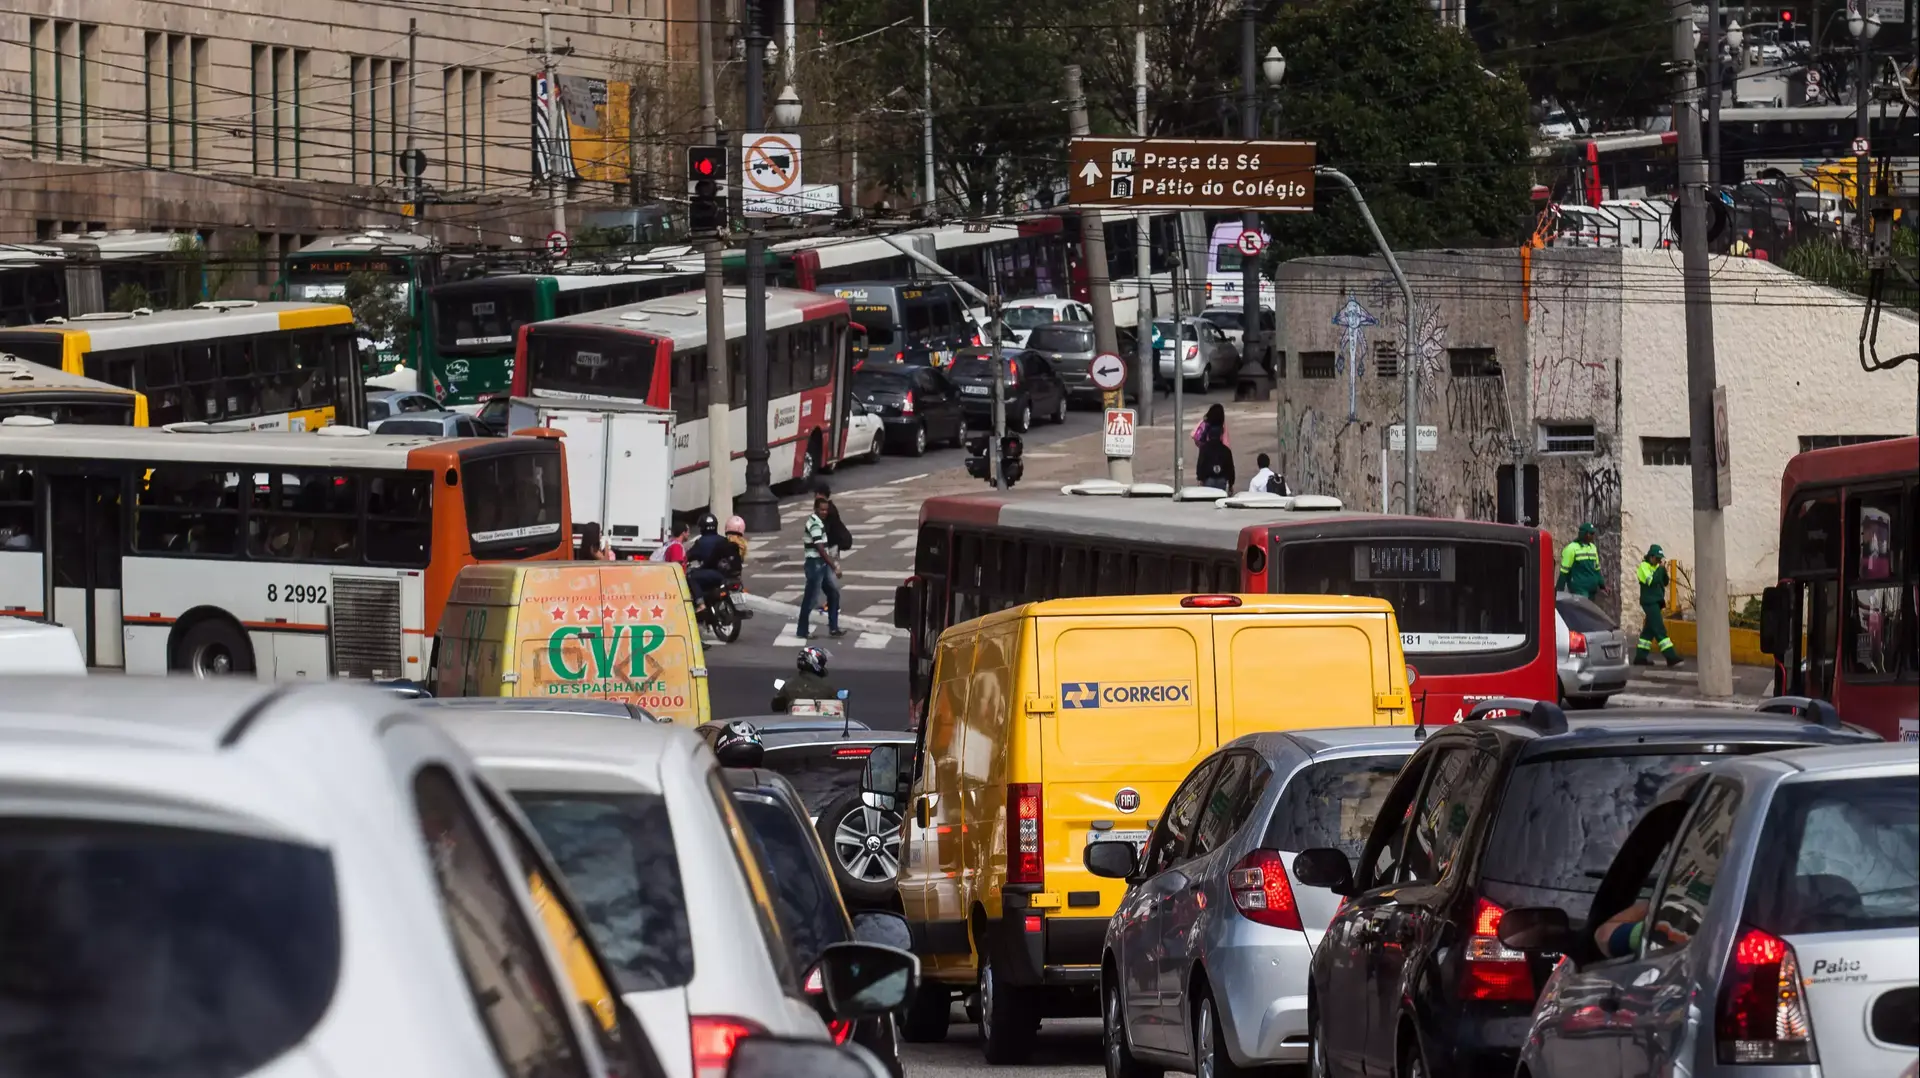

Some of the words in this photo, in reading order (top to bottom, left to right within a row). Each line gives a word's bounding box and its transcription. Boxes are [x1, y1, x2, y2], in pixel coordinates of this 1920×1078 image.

[1144, 153, 1200, 173] Praça
[1207, 153, 1229, 170] da
[1236, 153, 1261, 171] Sé
[1142, 178, 1194, 196] Pátio
[1201, 179, 1224, 196] do
[1233, 179, 1306, 200] Colégio
[1418, 428, 1437, 437] Pedro
[268, 583, 278, 602] 8
[284, 584, 327, 604] 2992
[548, 624, 666, 680] CVP
[549, 681, 666, 694] DESPACHANTE
[1103, 685, 1189, 702] CORREIOS
[637, 696, 684, 708] 4000
[1121, 794, 1135, 807] FIAT
[1813, 957, 1861, 976] Palio
